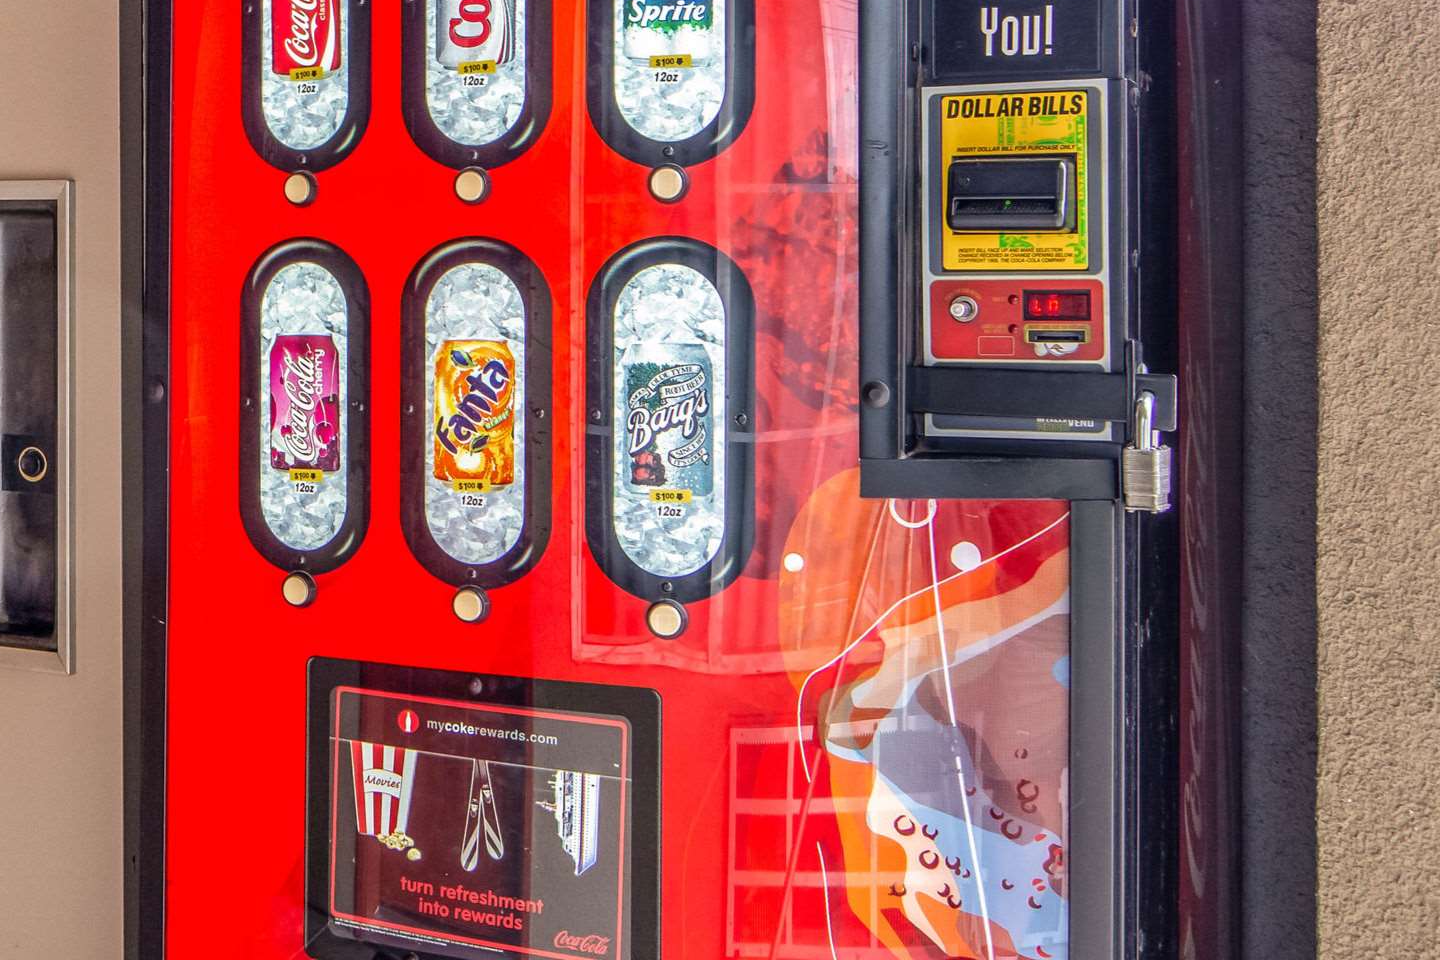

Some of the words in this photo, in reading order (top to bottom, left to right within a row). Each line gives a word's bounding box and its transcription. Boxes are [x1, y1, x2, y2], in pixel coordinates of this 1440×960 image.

[981, 5, 1053, 56] You!
[297, 83, 316, 94] 12oz
[463, 76, 484, 86] 12oz
[655, 72, 679, 82] 12oz
[947, 97, 1024, 119] DOLLAR
[1028, 94, 1083, 116] BILLS
[314, 348, 326, 395] cherry
[283, 346, 315, 461] Coca-Cola
[436, 360, 510, 455] Fanta
[627, 389, 709, 456] Barq's
[295, 483, 315, 493] 12oz
[462, 496, 484, 506] 12oz
[658, 507, 682, 517] 12oz
[427, 719, 558, 746] mycokerewards.com
[365, 774, 401, 789] Movies
[400, 876, 434, 896] turn
[440, 885, 544, 914] refreshment
[419, 897, 450, 918] into
[455, 907, 523, 930] rewards
[553, 930, 612, 955] Coca-Cola
